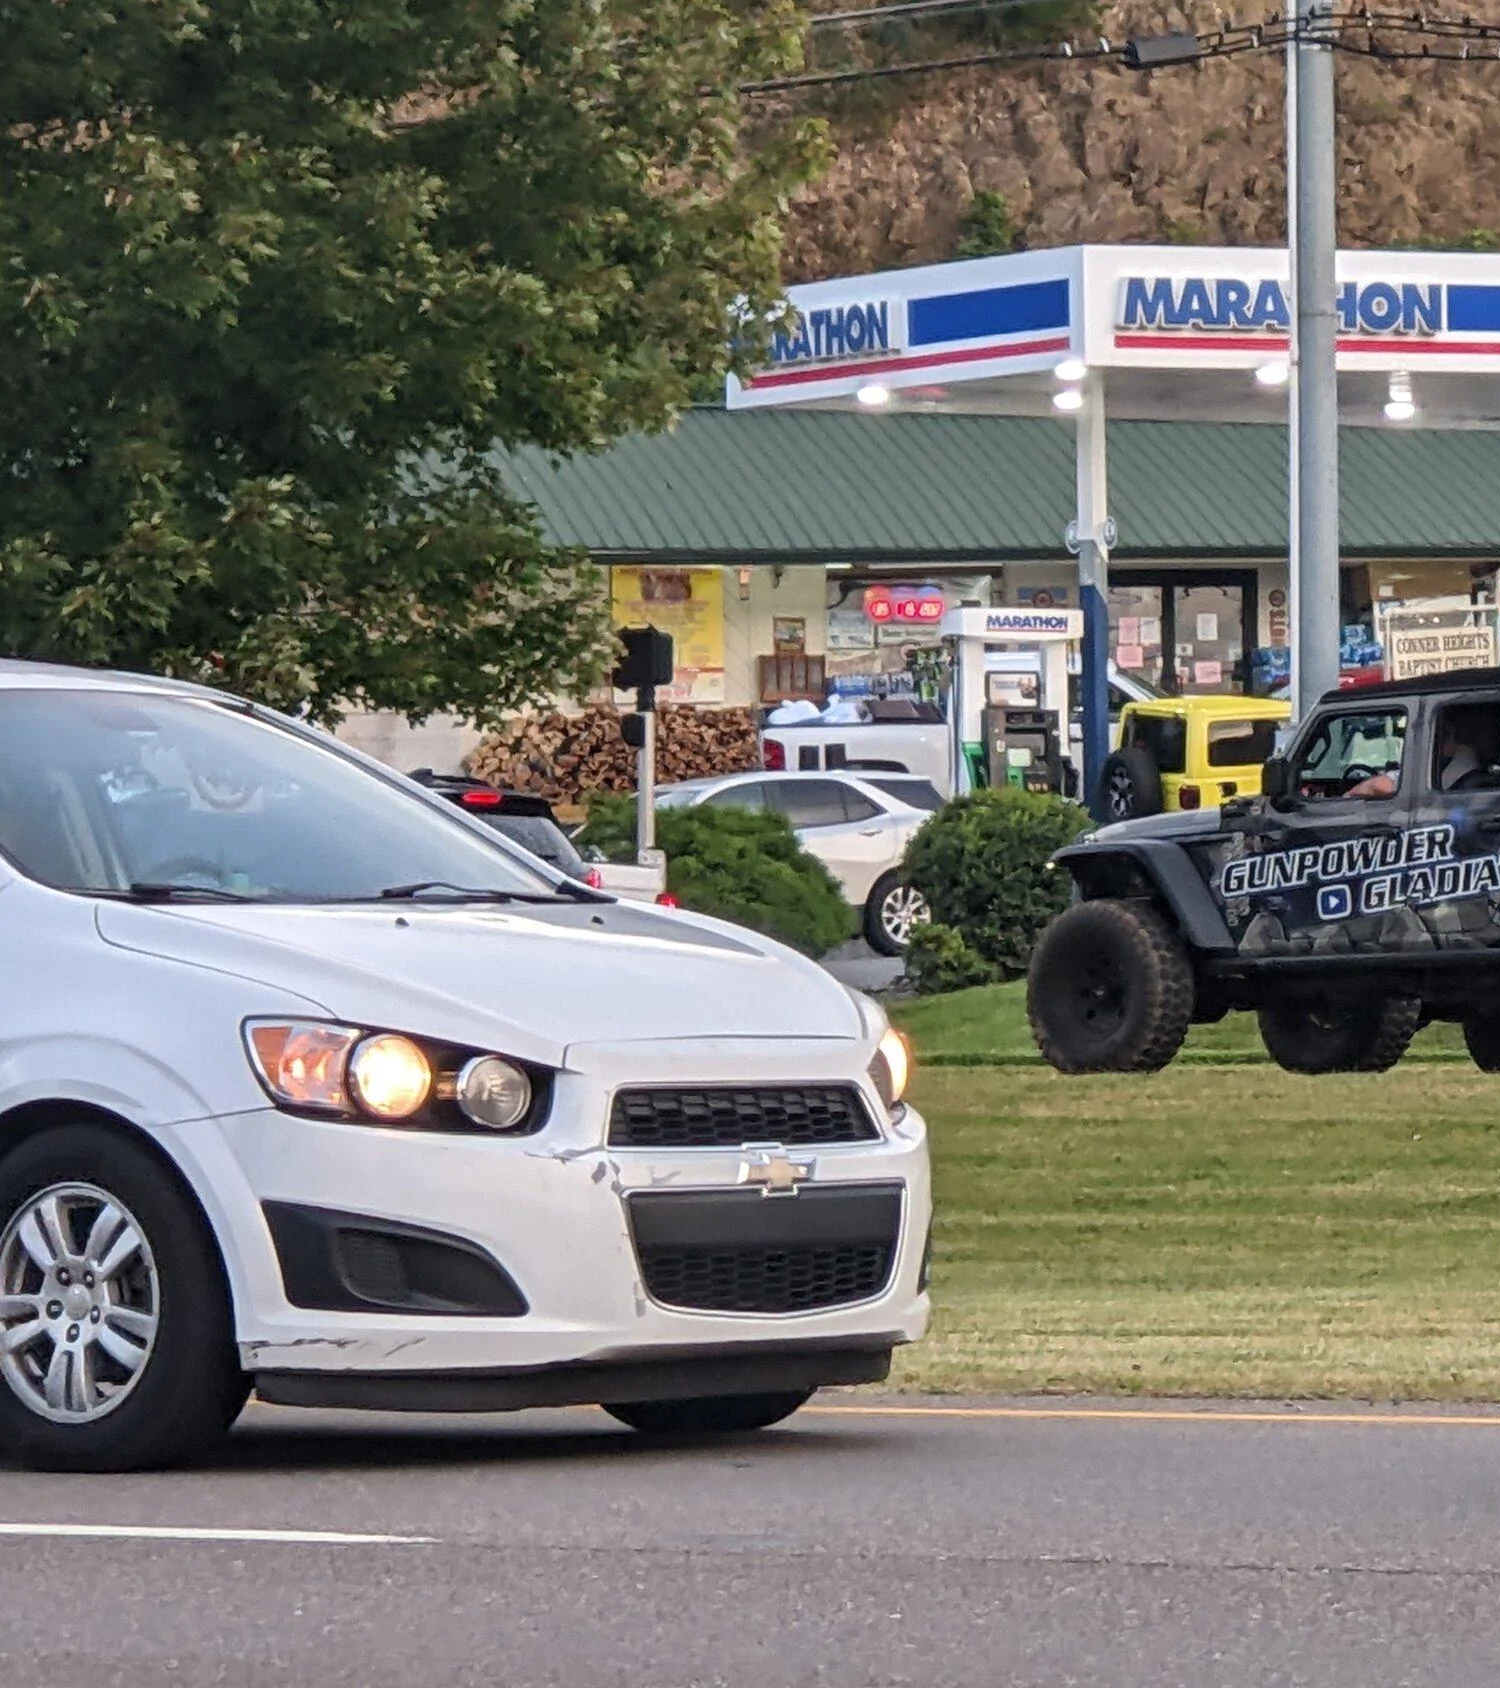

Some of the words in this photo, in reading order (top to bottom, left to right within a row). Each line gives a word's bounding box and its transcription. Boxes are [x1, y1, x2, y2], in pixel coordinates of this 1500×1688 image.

[1123, 277, 1443, 331] MARAHON
[986, 615, 1068, 629] MARATHON
[1221, 823, 1456, 898] GUNPOWDER
